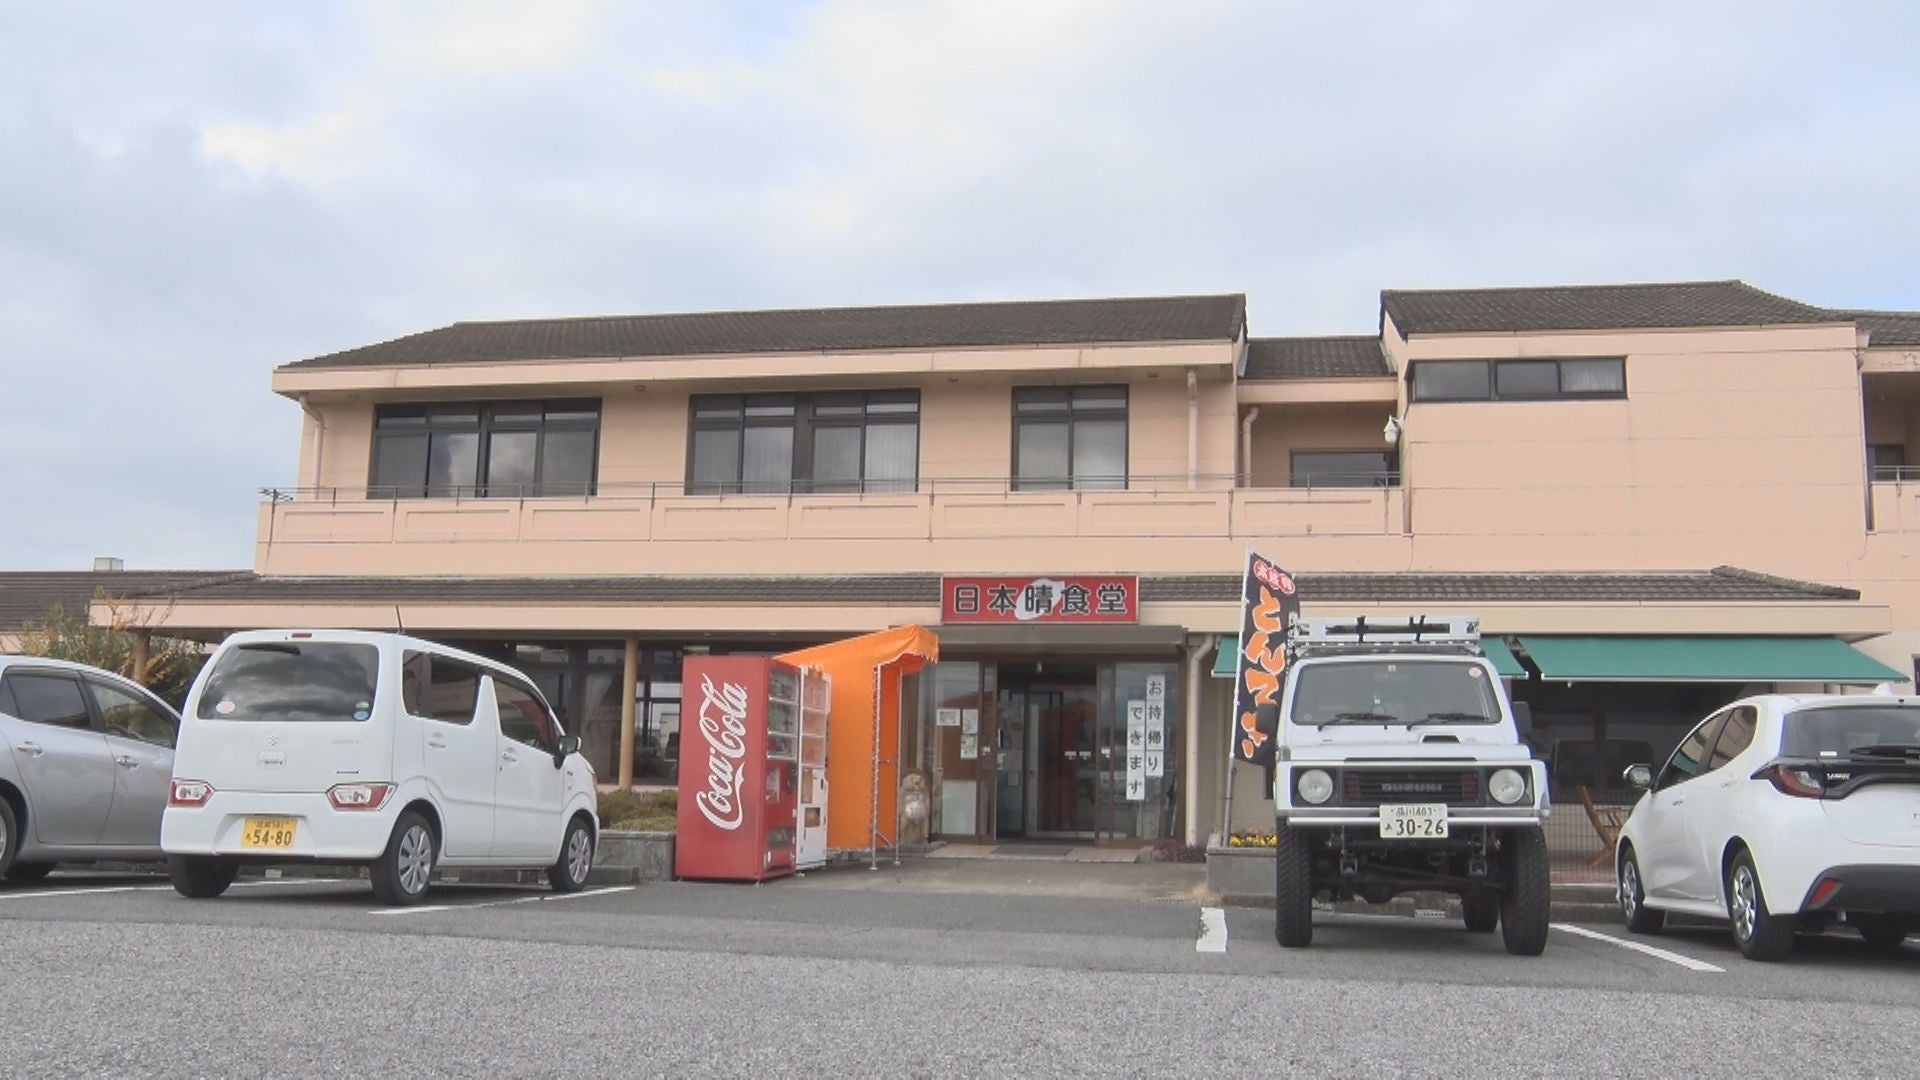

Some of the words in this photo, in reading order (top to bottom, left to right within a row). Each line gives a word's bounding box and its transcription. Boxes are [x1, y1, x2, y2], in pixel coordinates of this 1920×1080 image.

[954, 583, 1128, 615] 日本晴食堂
[697, 673, 748, 831] Coca-Cola
[1129, 705, 1143, 795] できます
[1147, 680, 1162, 772] お持帰り
[252, 829, 293, 846] 54-80
[1395, 818, 1444, 836] 30-26
